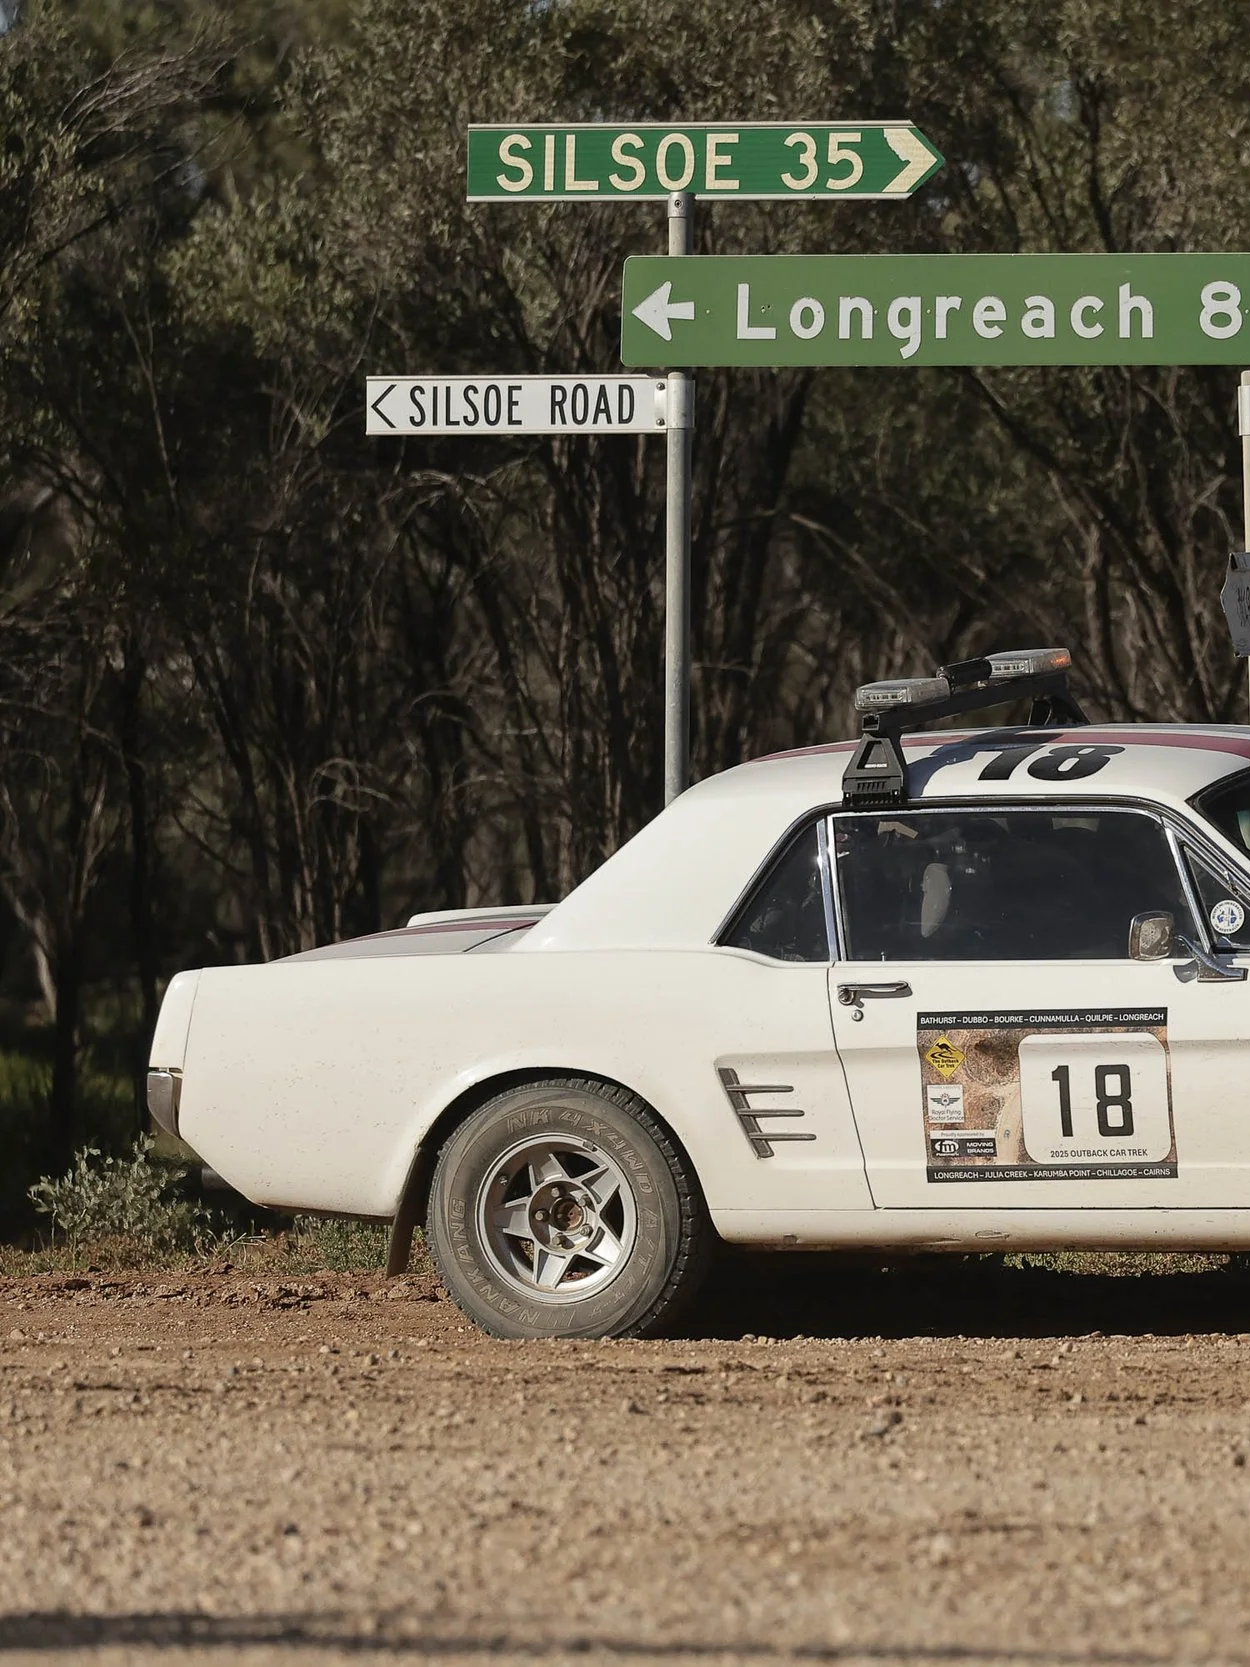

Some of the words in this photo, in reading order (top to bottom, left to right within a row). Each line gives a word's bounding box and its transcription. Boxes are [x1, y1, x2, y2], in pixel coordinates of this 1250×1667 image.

[495, 132, 741, 193] SILSOE
[780, 131, 864, 192] 35
[736, 282, 1154, 360] Longreach
[408, 384, 524, 427] SILSOE
[550, 383, 636, 426] ROAD
[977, 744, 1126, 782] 18
[920, 1016, 956, 1025] BATHURST
[962, 1015, 989, 1024] DUBBO
[994, 1015, 1024, 1023] BOURKE
[1029, 1014, 1080, 1023] CUNNAMULLA
[1085, 1013, 1113, 1022] QUILPIE
[1119, 1013, 1164, 1021] LONGREACH
[1051, 1064, 1134, 1137] 18
[506, 1108, 551, 1134] NK
[558, 1110, 655, 1195] 4X4WD
[933, 1171, 979, 1180] LONGREACH
[984, 1171, 1004, 1179] JULIA
[1004, 1170, 1028, 1178] CREEK
[1033, 1169, 1070, 1178] KARUMBA
[1069, 1169, 1091, 1177] POINT
[1096, 1168, 1138, 1177] CHILLAGOE
[1143, 1168, 1170, 1176] CAIRNS
[1050, 1150, 1069, 1158] 2025
[1070, 1149, 1108, 1158] OUTBACK
[1109, 1149, 1126, 1157] CAR
[1127, 1148, 1148, 1157] TREK
[450, 1198, 540, 1326] NANKANG
